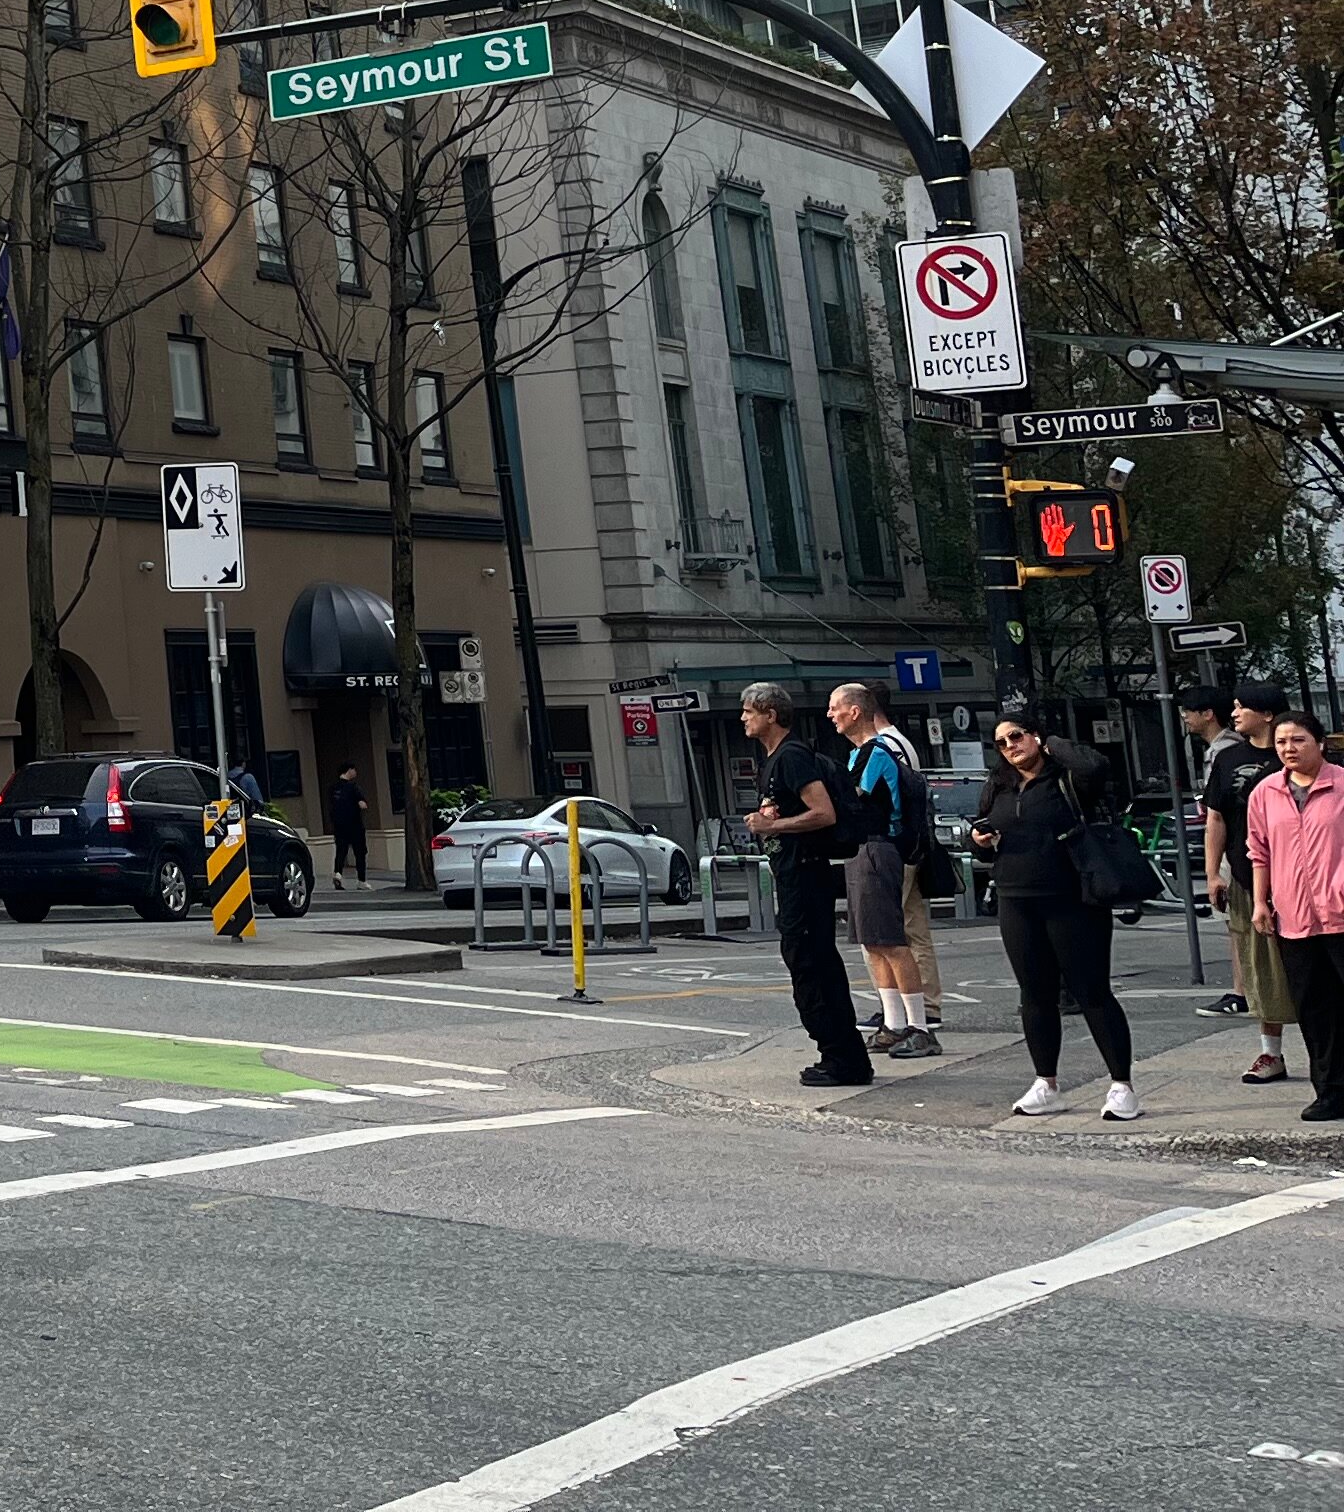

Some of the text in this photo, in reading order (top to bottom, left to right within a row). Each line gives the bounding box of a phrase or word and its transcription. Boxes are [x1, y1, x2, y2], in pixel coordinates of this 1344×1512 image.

[288, 35, 530, 104] Seymour St
[929, 330, 997, 352] EXCEPT
[923, 354, 1010, 377] BICYCLES
[1021, 406, 1166, 439] Seymour St
[1149, 416, 1173, 427] 500
[1091, 503, 1114, 551] 0
[346, 676, 369, 687] ST.
[622, 680, 647, 690] Regis
